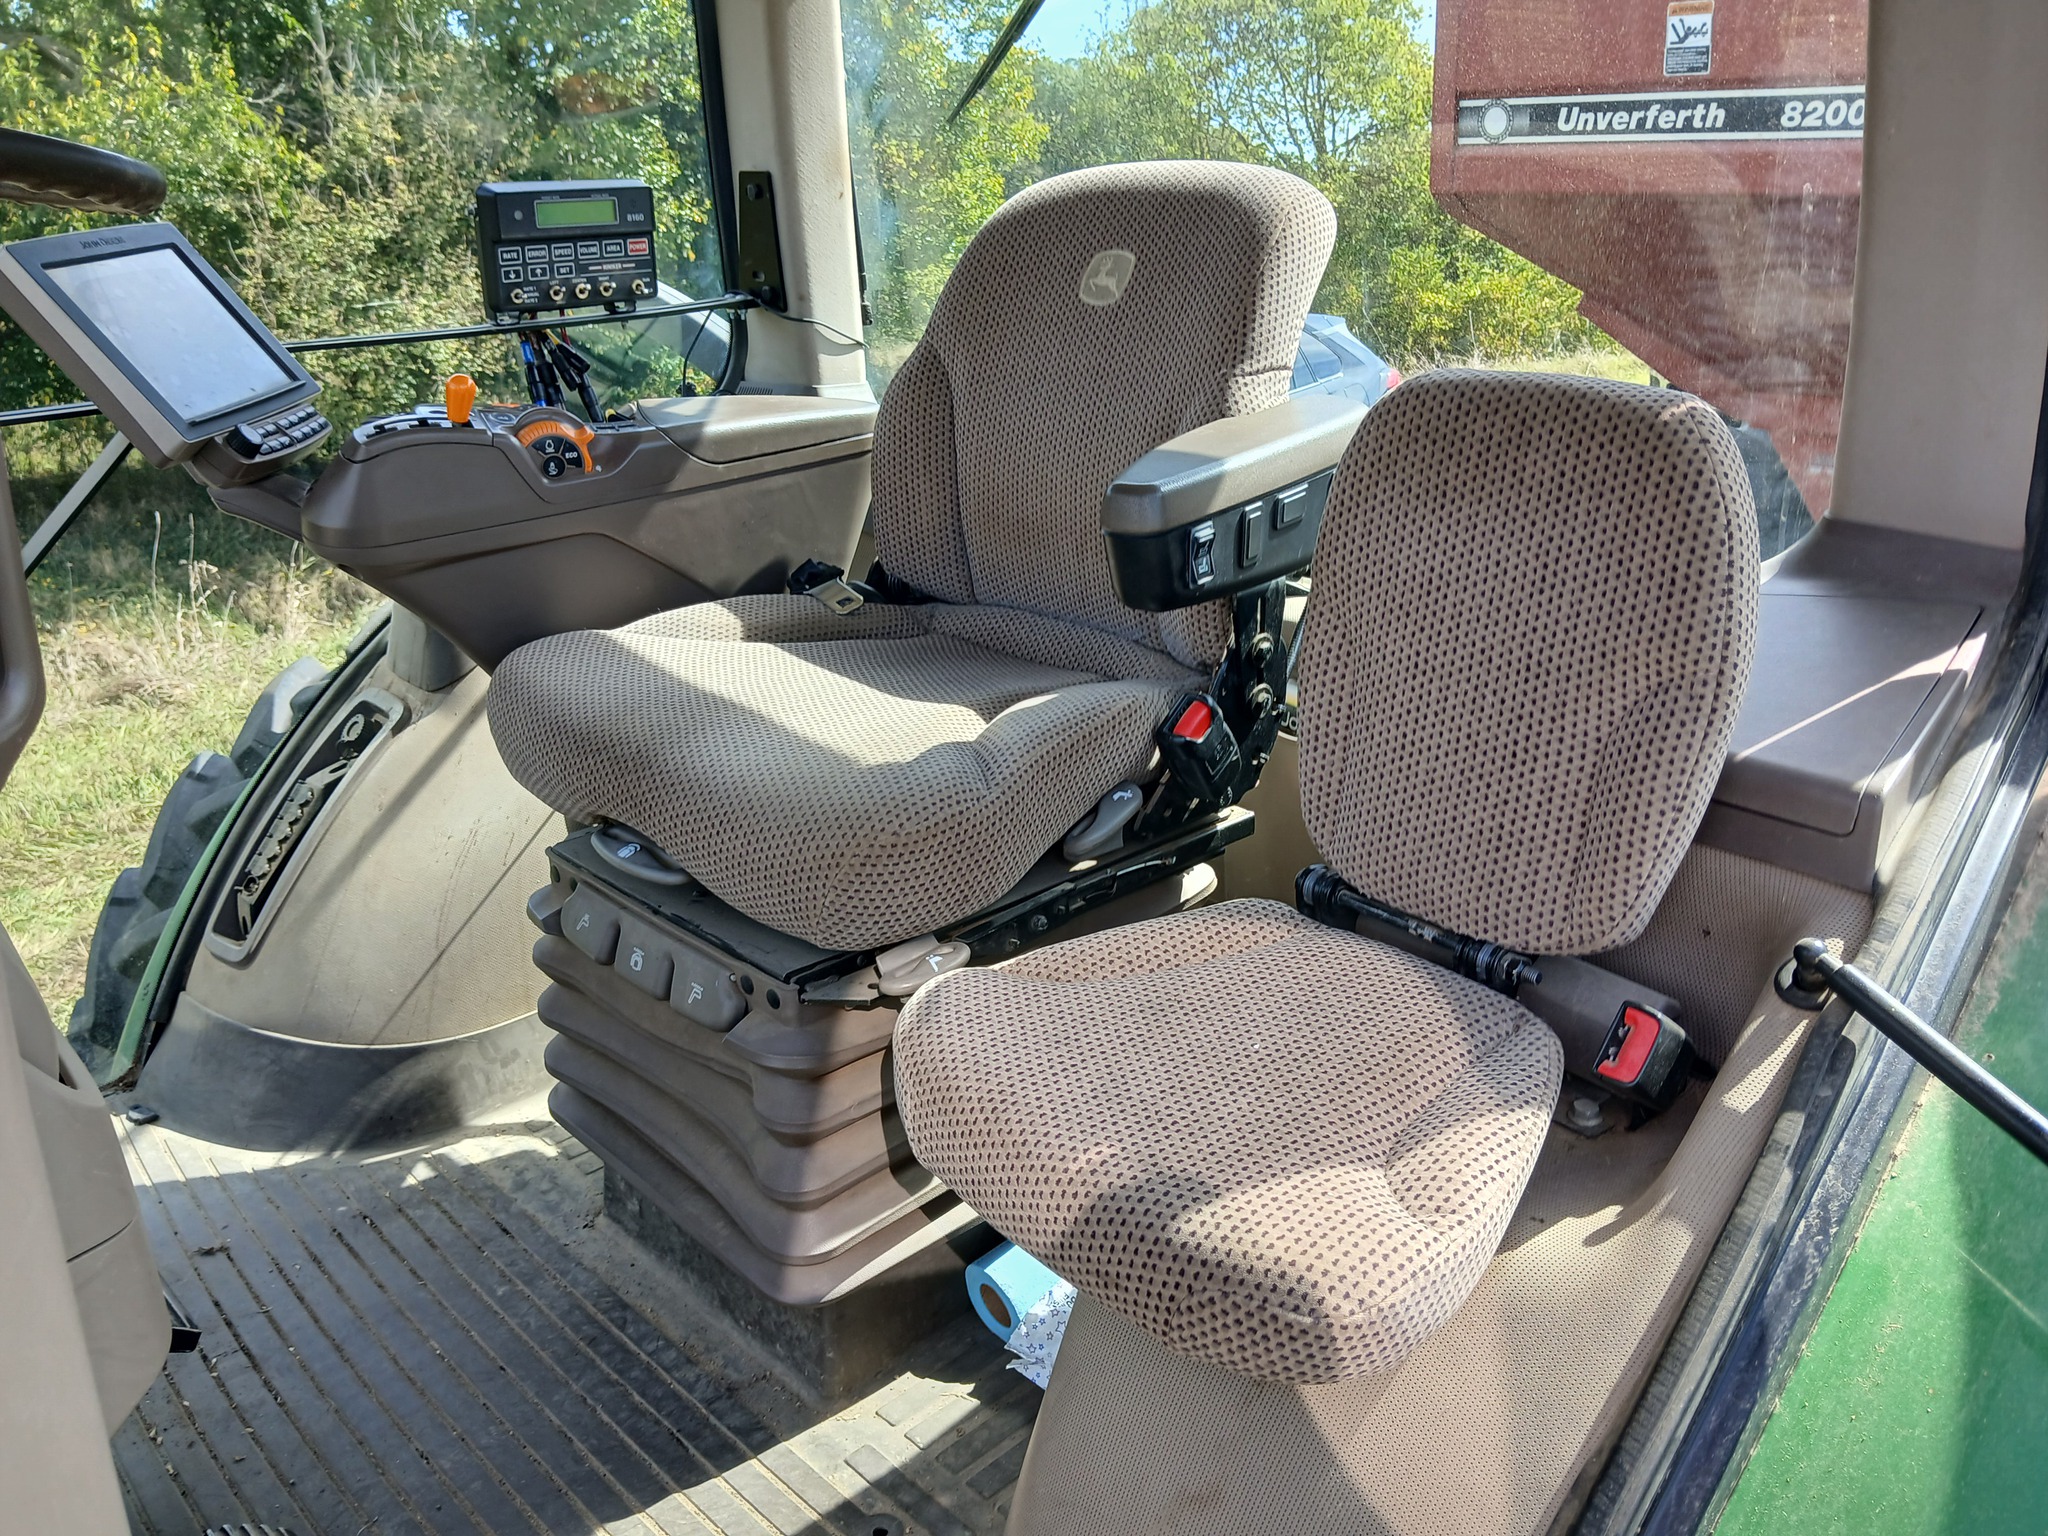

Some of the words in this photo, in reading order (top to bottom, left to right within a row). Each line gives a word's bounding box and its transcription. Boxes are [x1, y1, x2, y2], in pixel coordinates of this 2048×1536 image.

[1557, 103, 1726, 132] Unverferth
[1780, 99, 1865, 128] 8200
[554, 247, 572, 256] SPEED
[606, 244, 621, 252] AREA
[629, 243, 647, 251] POWER
[502, 251, 518, 260] RATE
[528, 249, 547, 258] ERROR
[565, 451, 578, 459] ECO
